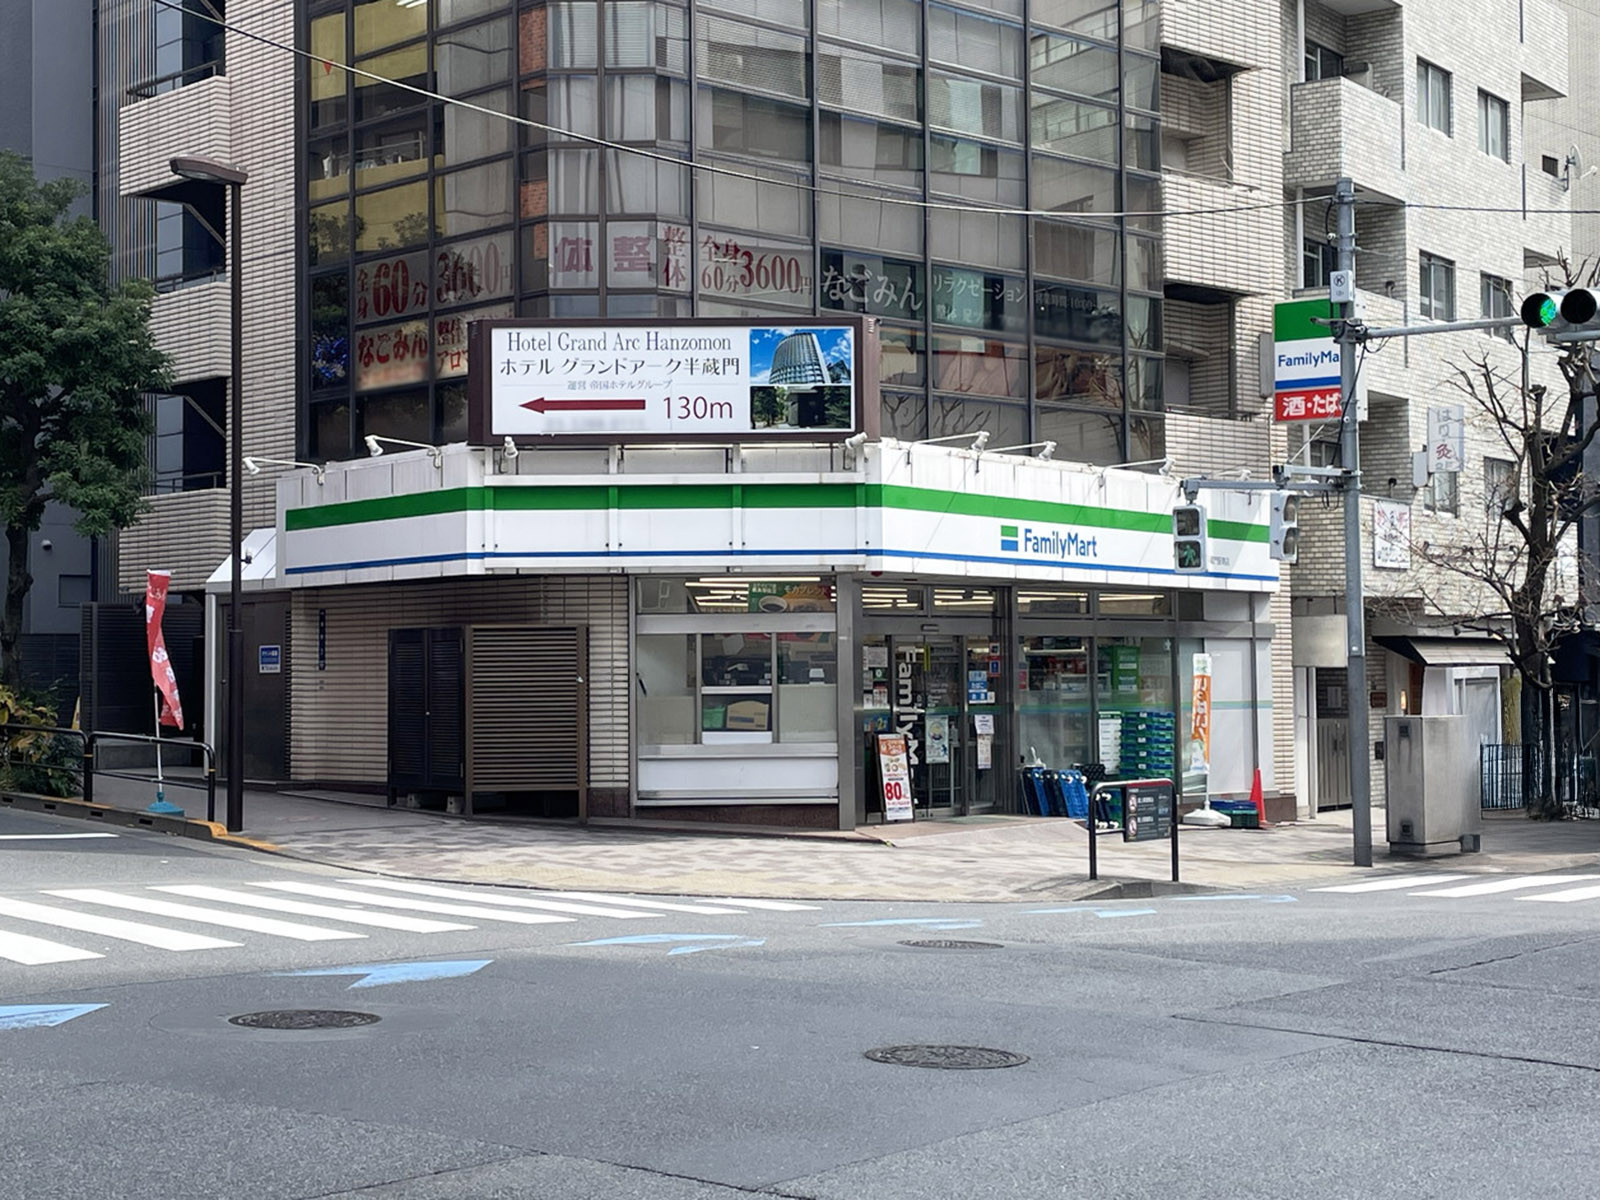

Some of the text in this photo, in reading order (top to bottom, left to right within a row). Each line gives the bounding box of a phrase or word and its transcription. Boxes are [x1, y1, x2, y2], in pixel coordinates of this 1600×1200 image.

[663, 225, 687, 288] 整体
[820, 263, 924, 312] なごみん
[933, 273, 1027, 305] リラクゼーション
[507, 332, 731, 352] Hotel Grand Arc Hanzomon
[436, 349, 469, 375] アロ
[500, 357, 740, 377] ホテル グランドアーク半蔵門
[1278, 350, 1340, 368] FamilyMa
[663, 396, 733, 420] 130m
[1282, 394, 1341, 417] 酒・たば
[1024, 528, 1098, 559] FamilyMart
[884, 782, 903, 801] 80
